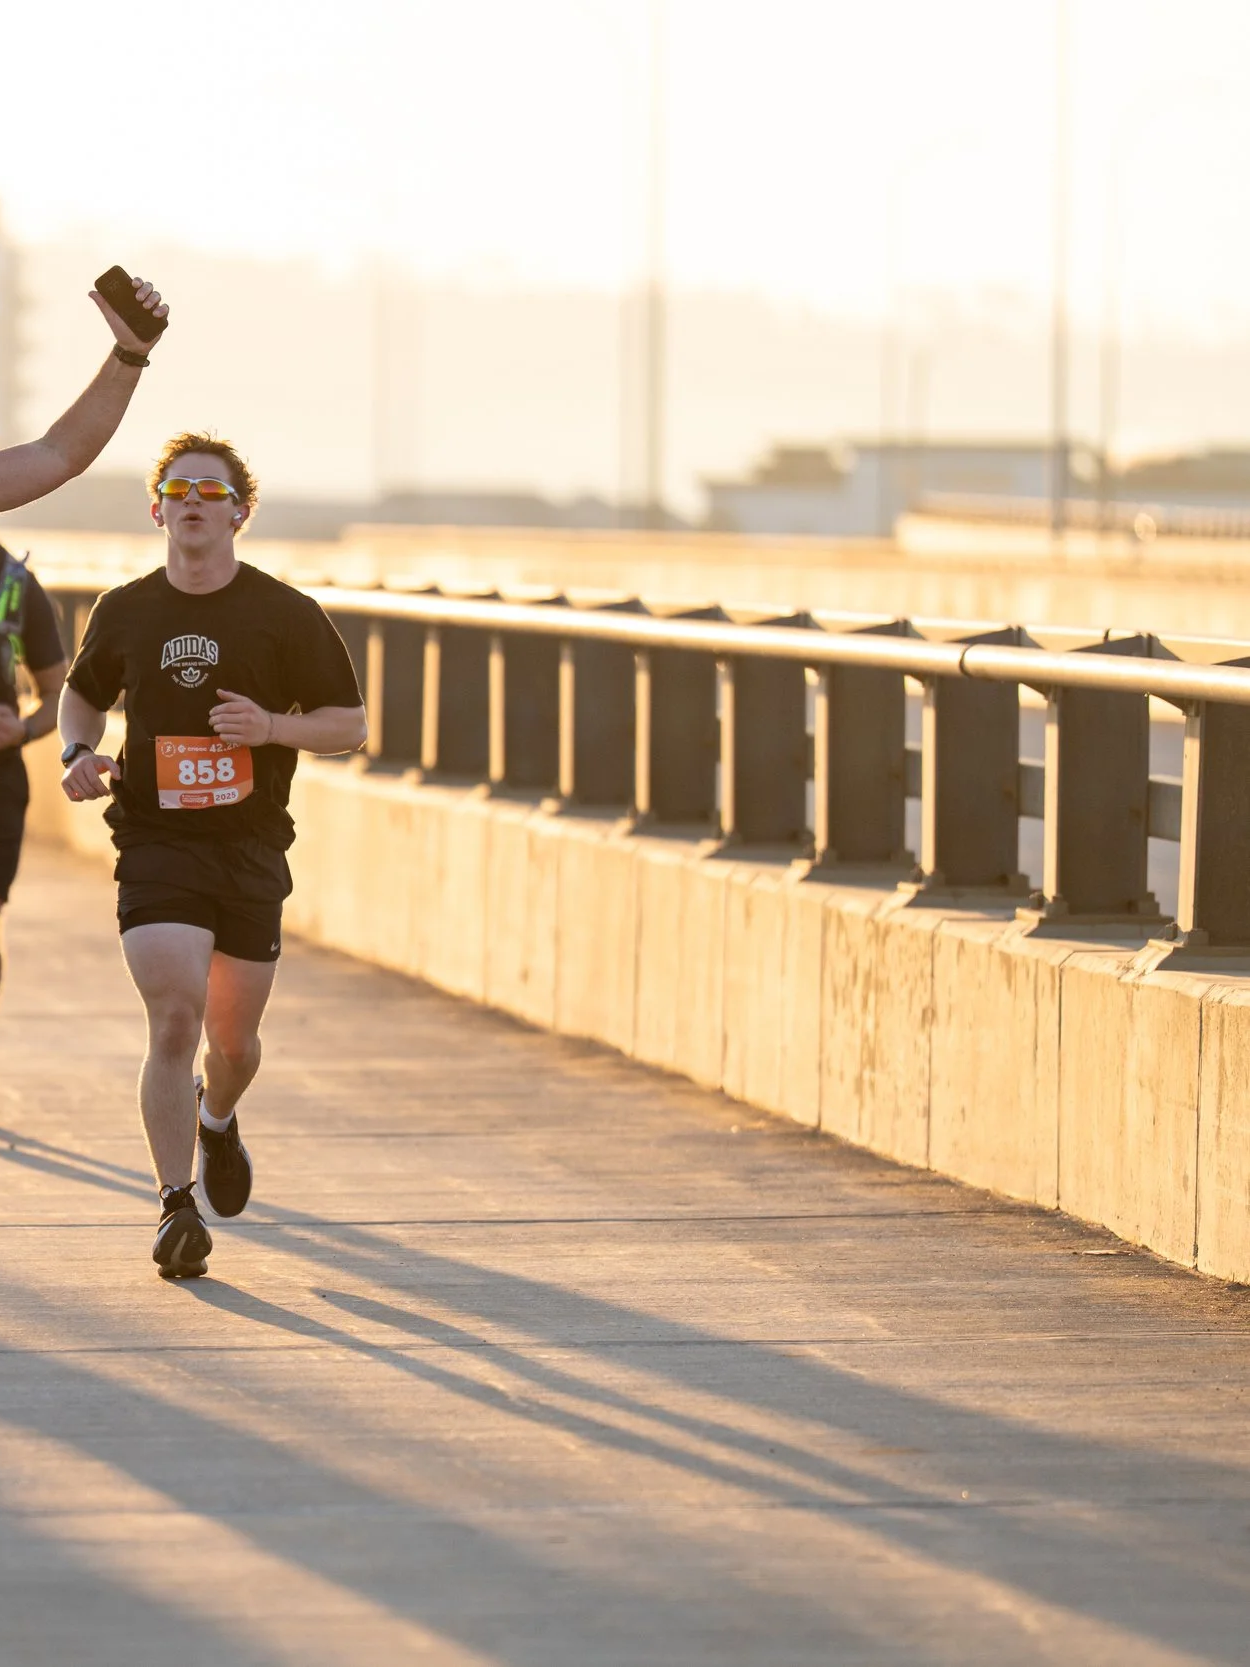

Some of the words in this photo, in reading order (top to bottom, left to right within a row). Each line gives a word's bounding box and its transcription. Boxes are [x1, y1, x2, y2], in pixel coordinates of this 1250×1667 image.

[160, 634, 219, 670] ADIDAS
[178, 757, 236, 786] 858
[215, 791, 237, 801] 2025
